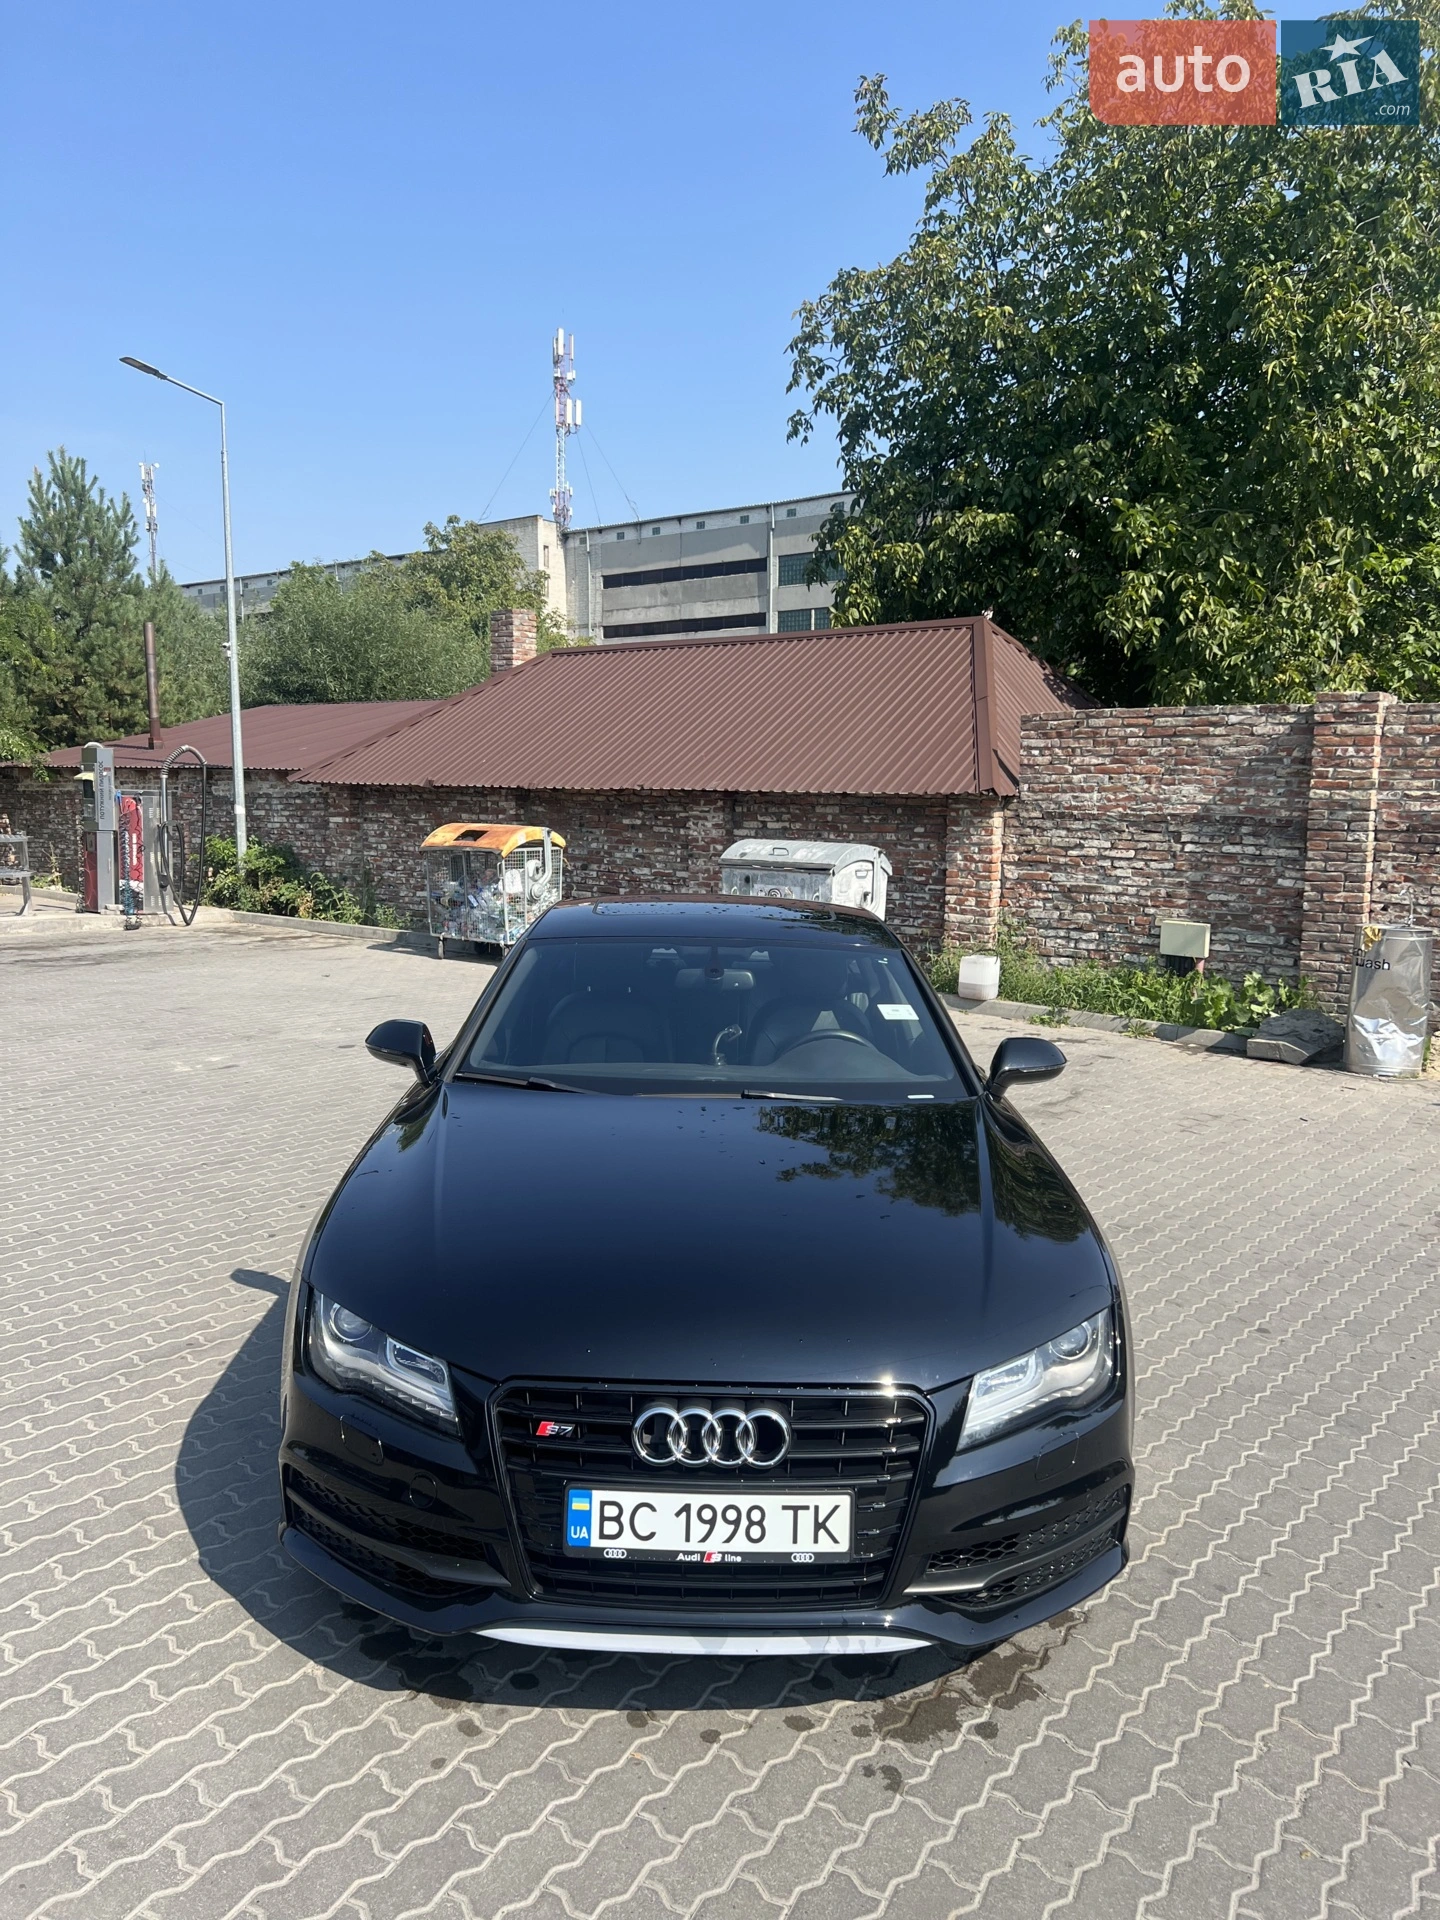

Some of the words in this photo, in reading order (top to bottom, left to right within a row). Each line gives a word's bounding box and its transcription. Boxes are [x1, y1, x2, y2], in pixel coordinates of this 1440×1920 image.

[599, 1500, 657, 1541] BC
[674, 1503, 766, 1544] 1998
[781, 1505, 841, 1544] TK
[570, 1525, 589, 1539] UA
[676, 1553, 701, 1562] Audi
[724, 1553, 742, 1562] line
